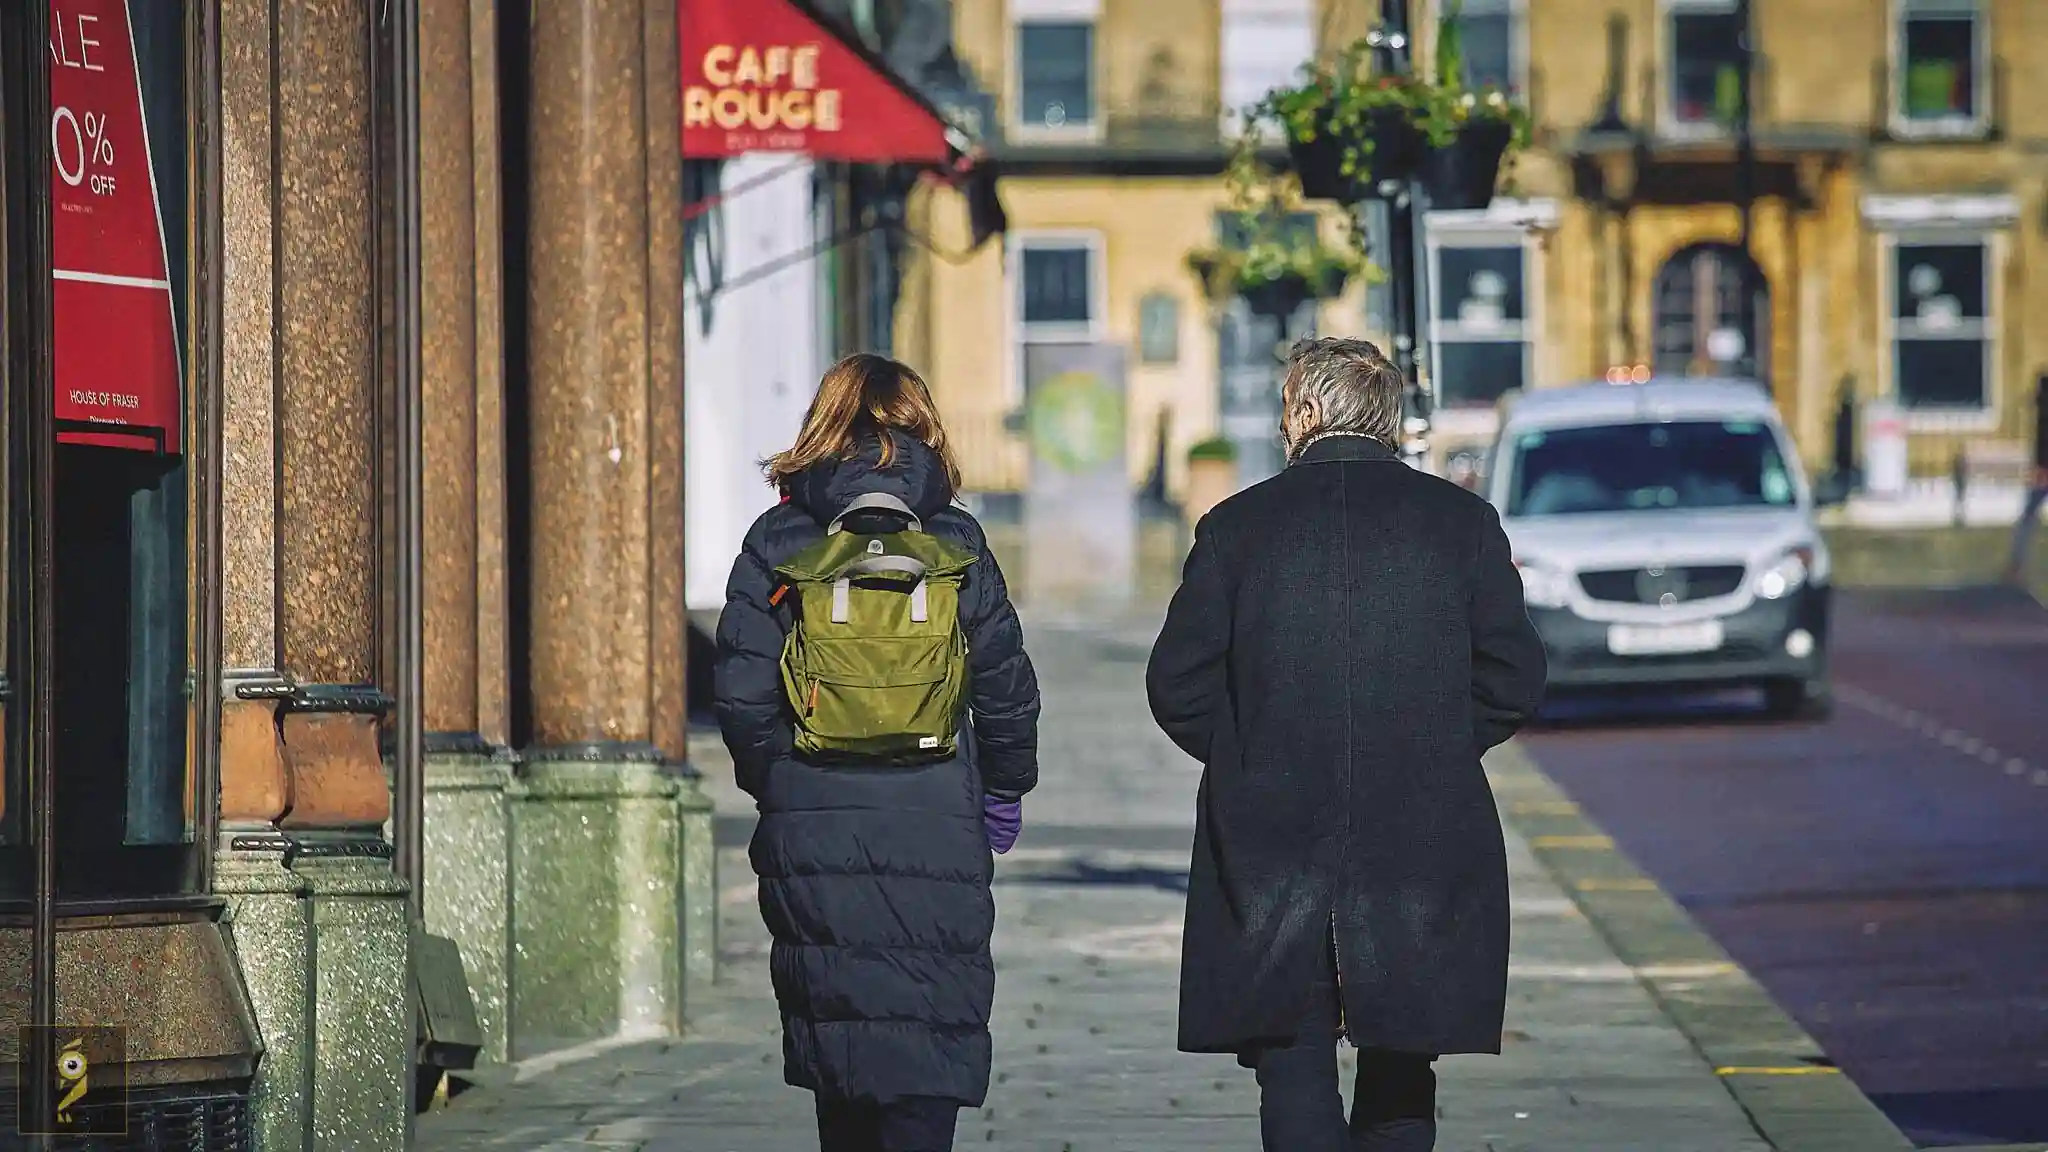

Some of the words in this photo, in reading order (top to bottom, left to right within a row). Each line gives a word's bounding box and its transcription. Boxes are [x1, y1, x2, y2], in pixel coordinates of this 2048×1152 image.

[50, 10, 104, 71] LE
[684, 86, 841, 131] ROUGE
[91, 174, 116, 196] OFF
[70, 390, 98, 405] HOUSE
[99, 393, 111, 407] OF
[112, 394, 139, 408] FRASER
